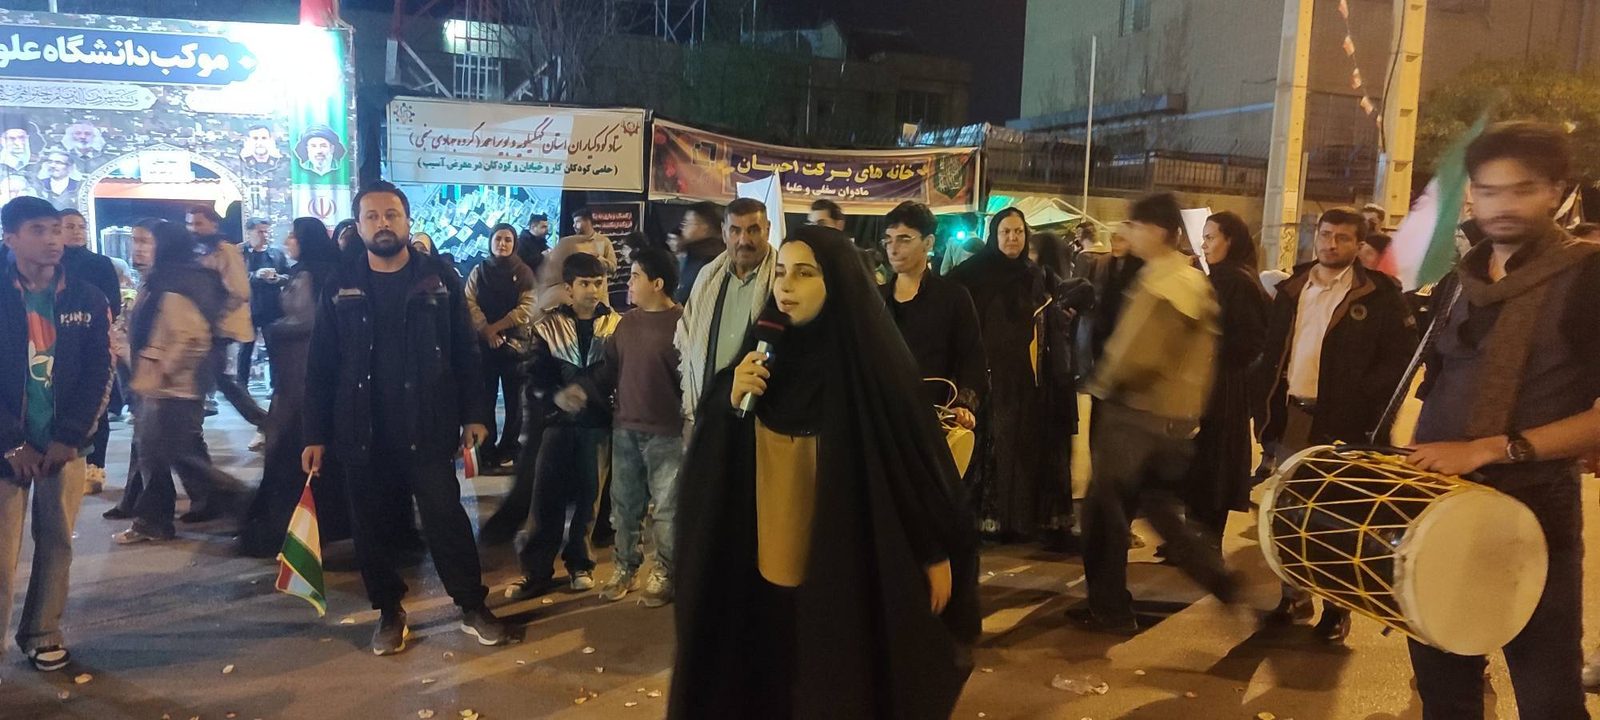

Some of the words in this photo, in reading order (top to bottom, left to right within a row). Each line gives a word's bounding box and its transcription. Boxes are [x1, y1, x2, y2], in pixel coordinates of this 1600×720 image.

[44, 33, 151, 68] دانشگاه
[150, 42, 229, 77] موکب
[542, 132, 567, 154] استان
[608, 134, 623, 153] ستاد
[472, 161, 483, 171] در
[483, 159, 512, 172] کودکان
[519, 161, 544, 173] خیابان
[551, 162, 562, 174] کار
[563, 163, 590, 175] کودکان
[737, 154, 799, 174] احسان
[854, 164, 883, 184] های
[886, 164, 914, 180] خانه
[785, 181, 803, 192] علیا
[805, 187, 811, 195] و
[812, 185, 836, 196] سفلی
[838, 185, 869, 198] مادوان
